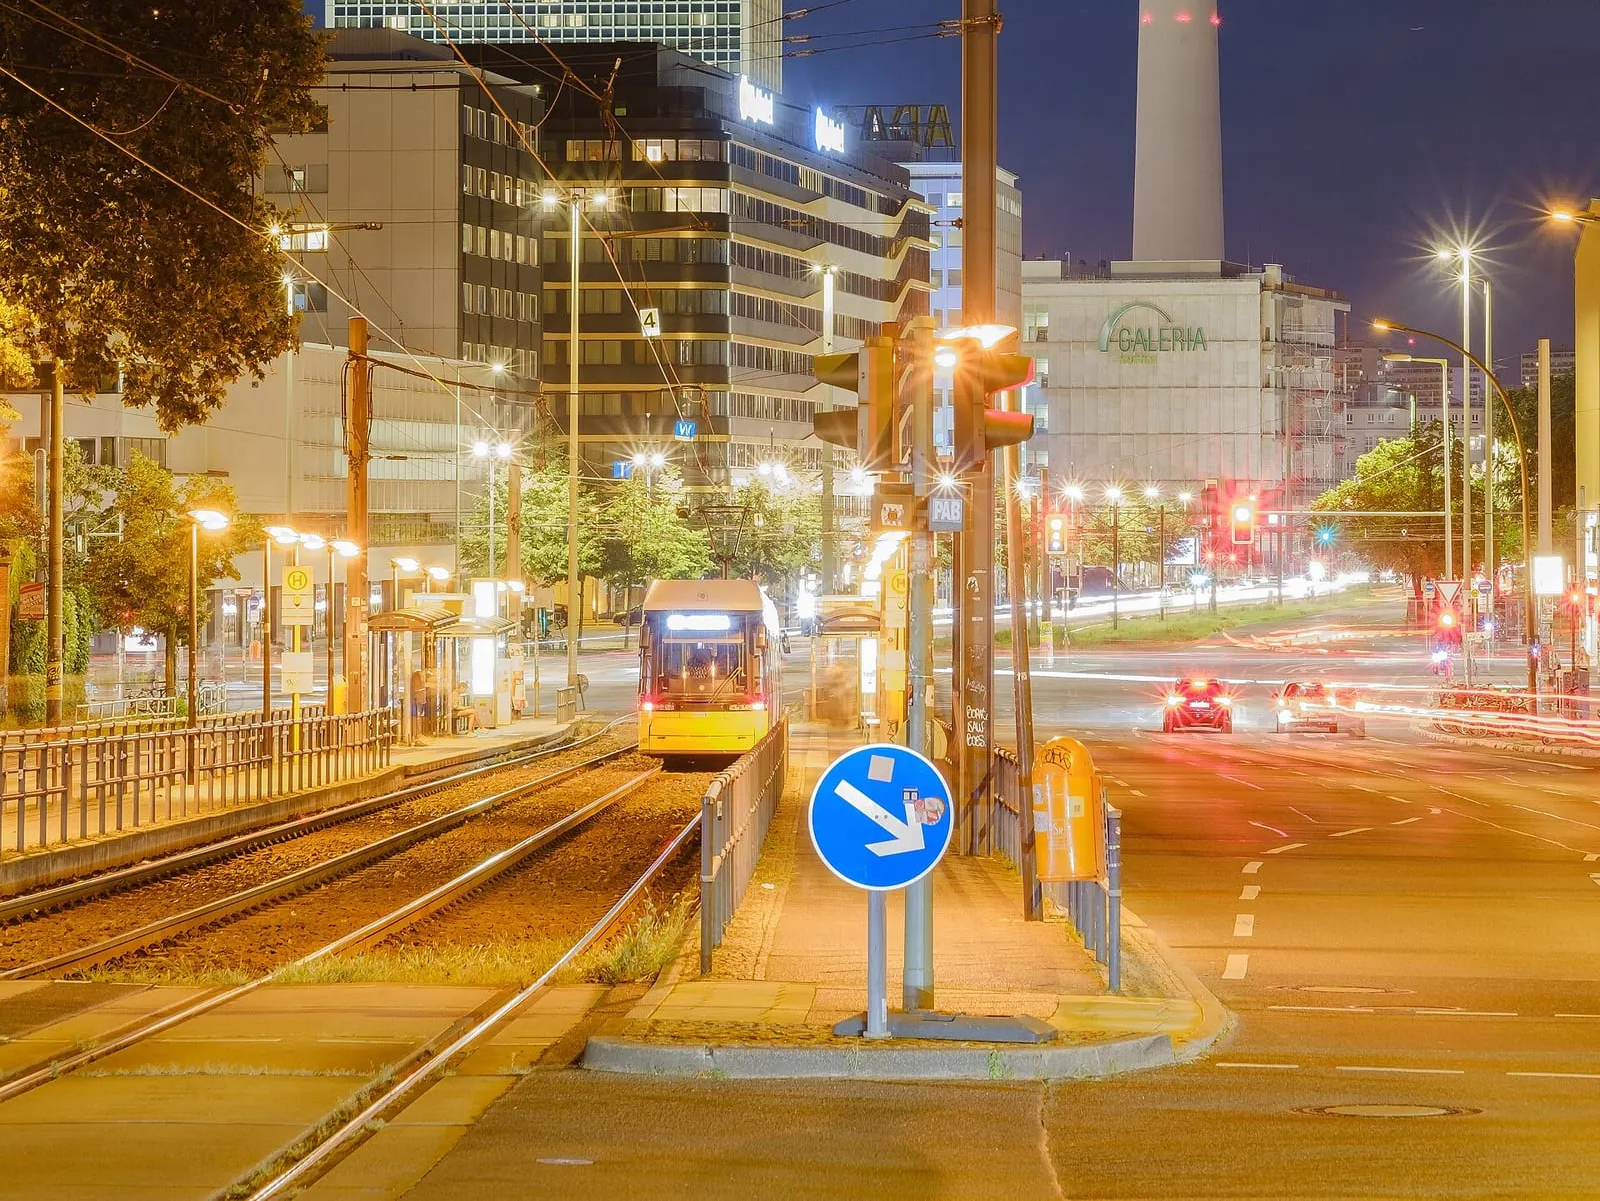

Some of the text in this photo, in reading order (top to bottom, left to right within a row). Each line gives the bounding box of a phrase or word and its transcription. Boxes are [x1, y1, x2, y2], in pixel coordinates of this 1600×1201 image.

[643, 311, 656, 328] 4
[1118, 326, 1207, 352] GALERIA
[679, 423, 692, 437] W
[933, 500, 961, 521] PAB
